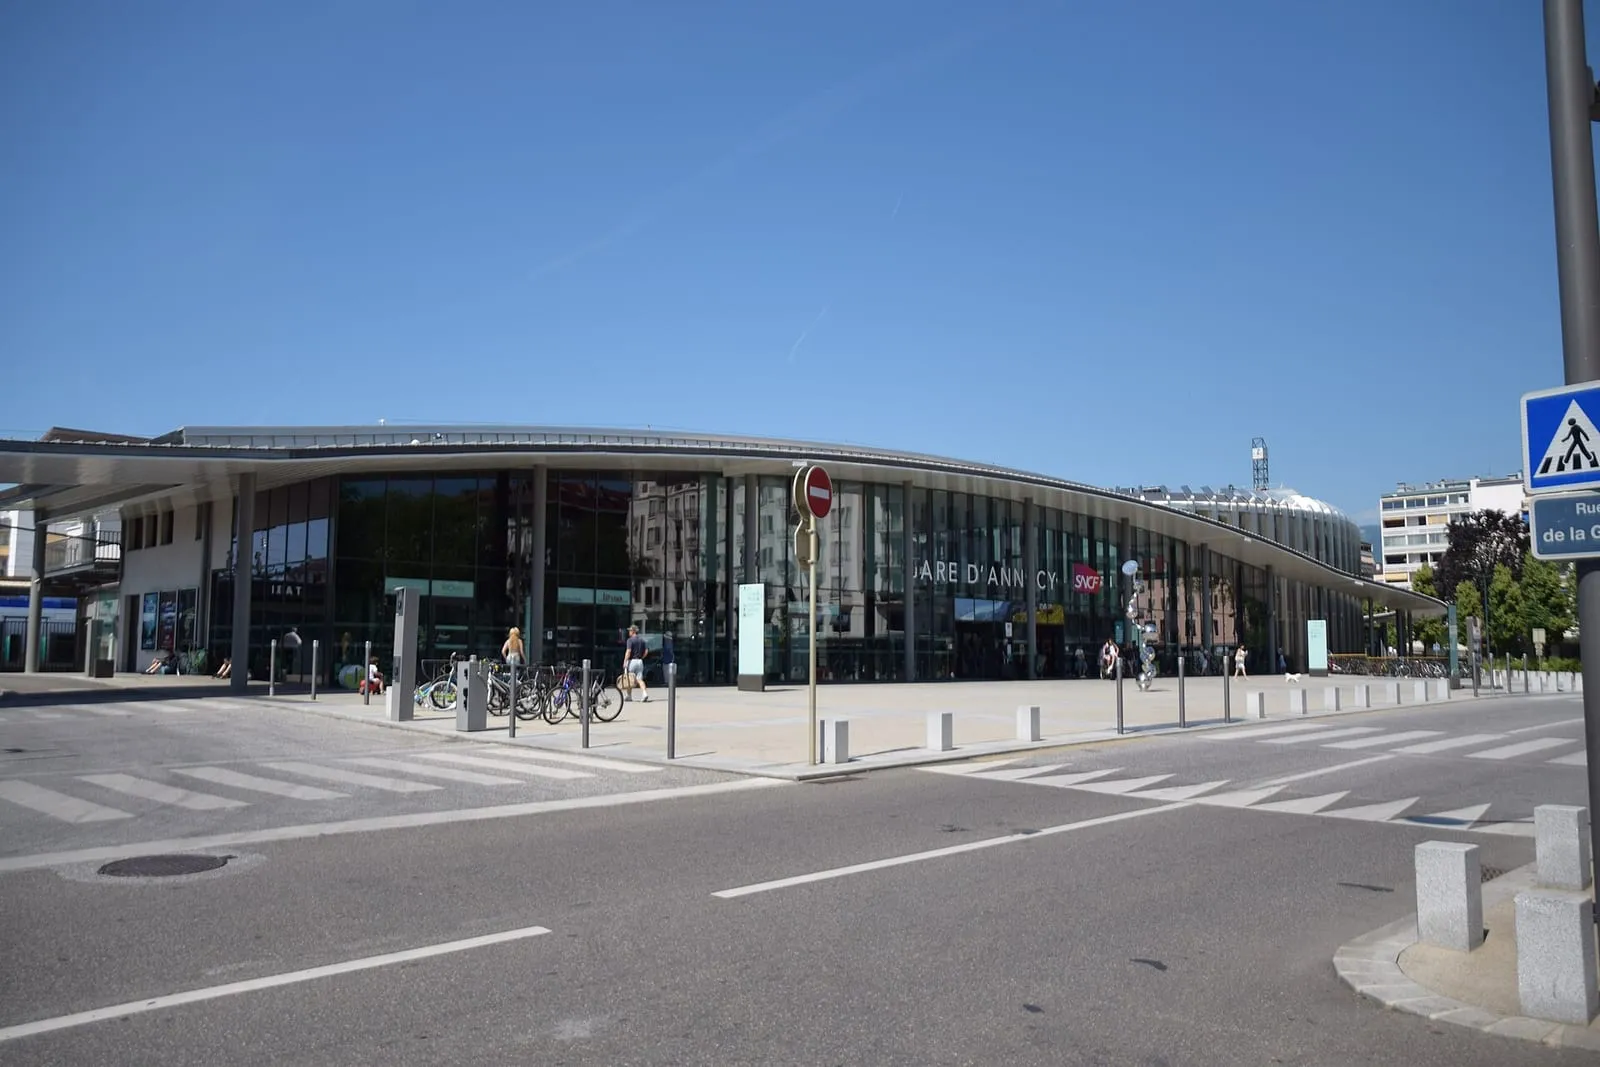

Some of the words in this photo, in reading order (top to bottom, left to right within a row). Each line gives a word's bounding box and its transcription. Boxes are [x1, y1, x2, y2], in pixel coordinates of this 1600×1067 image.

[1543, 528, 1565, 542] de
[1570, 526, 1585, 541] la
[967, 563, 1056, 590] D'ANNCY
[1074, 574, 1100, 590] SNCF
